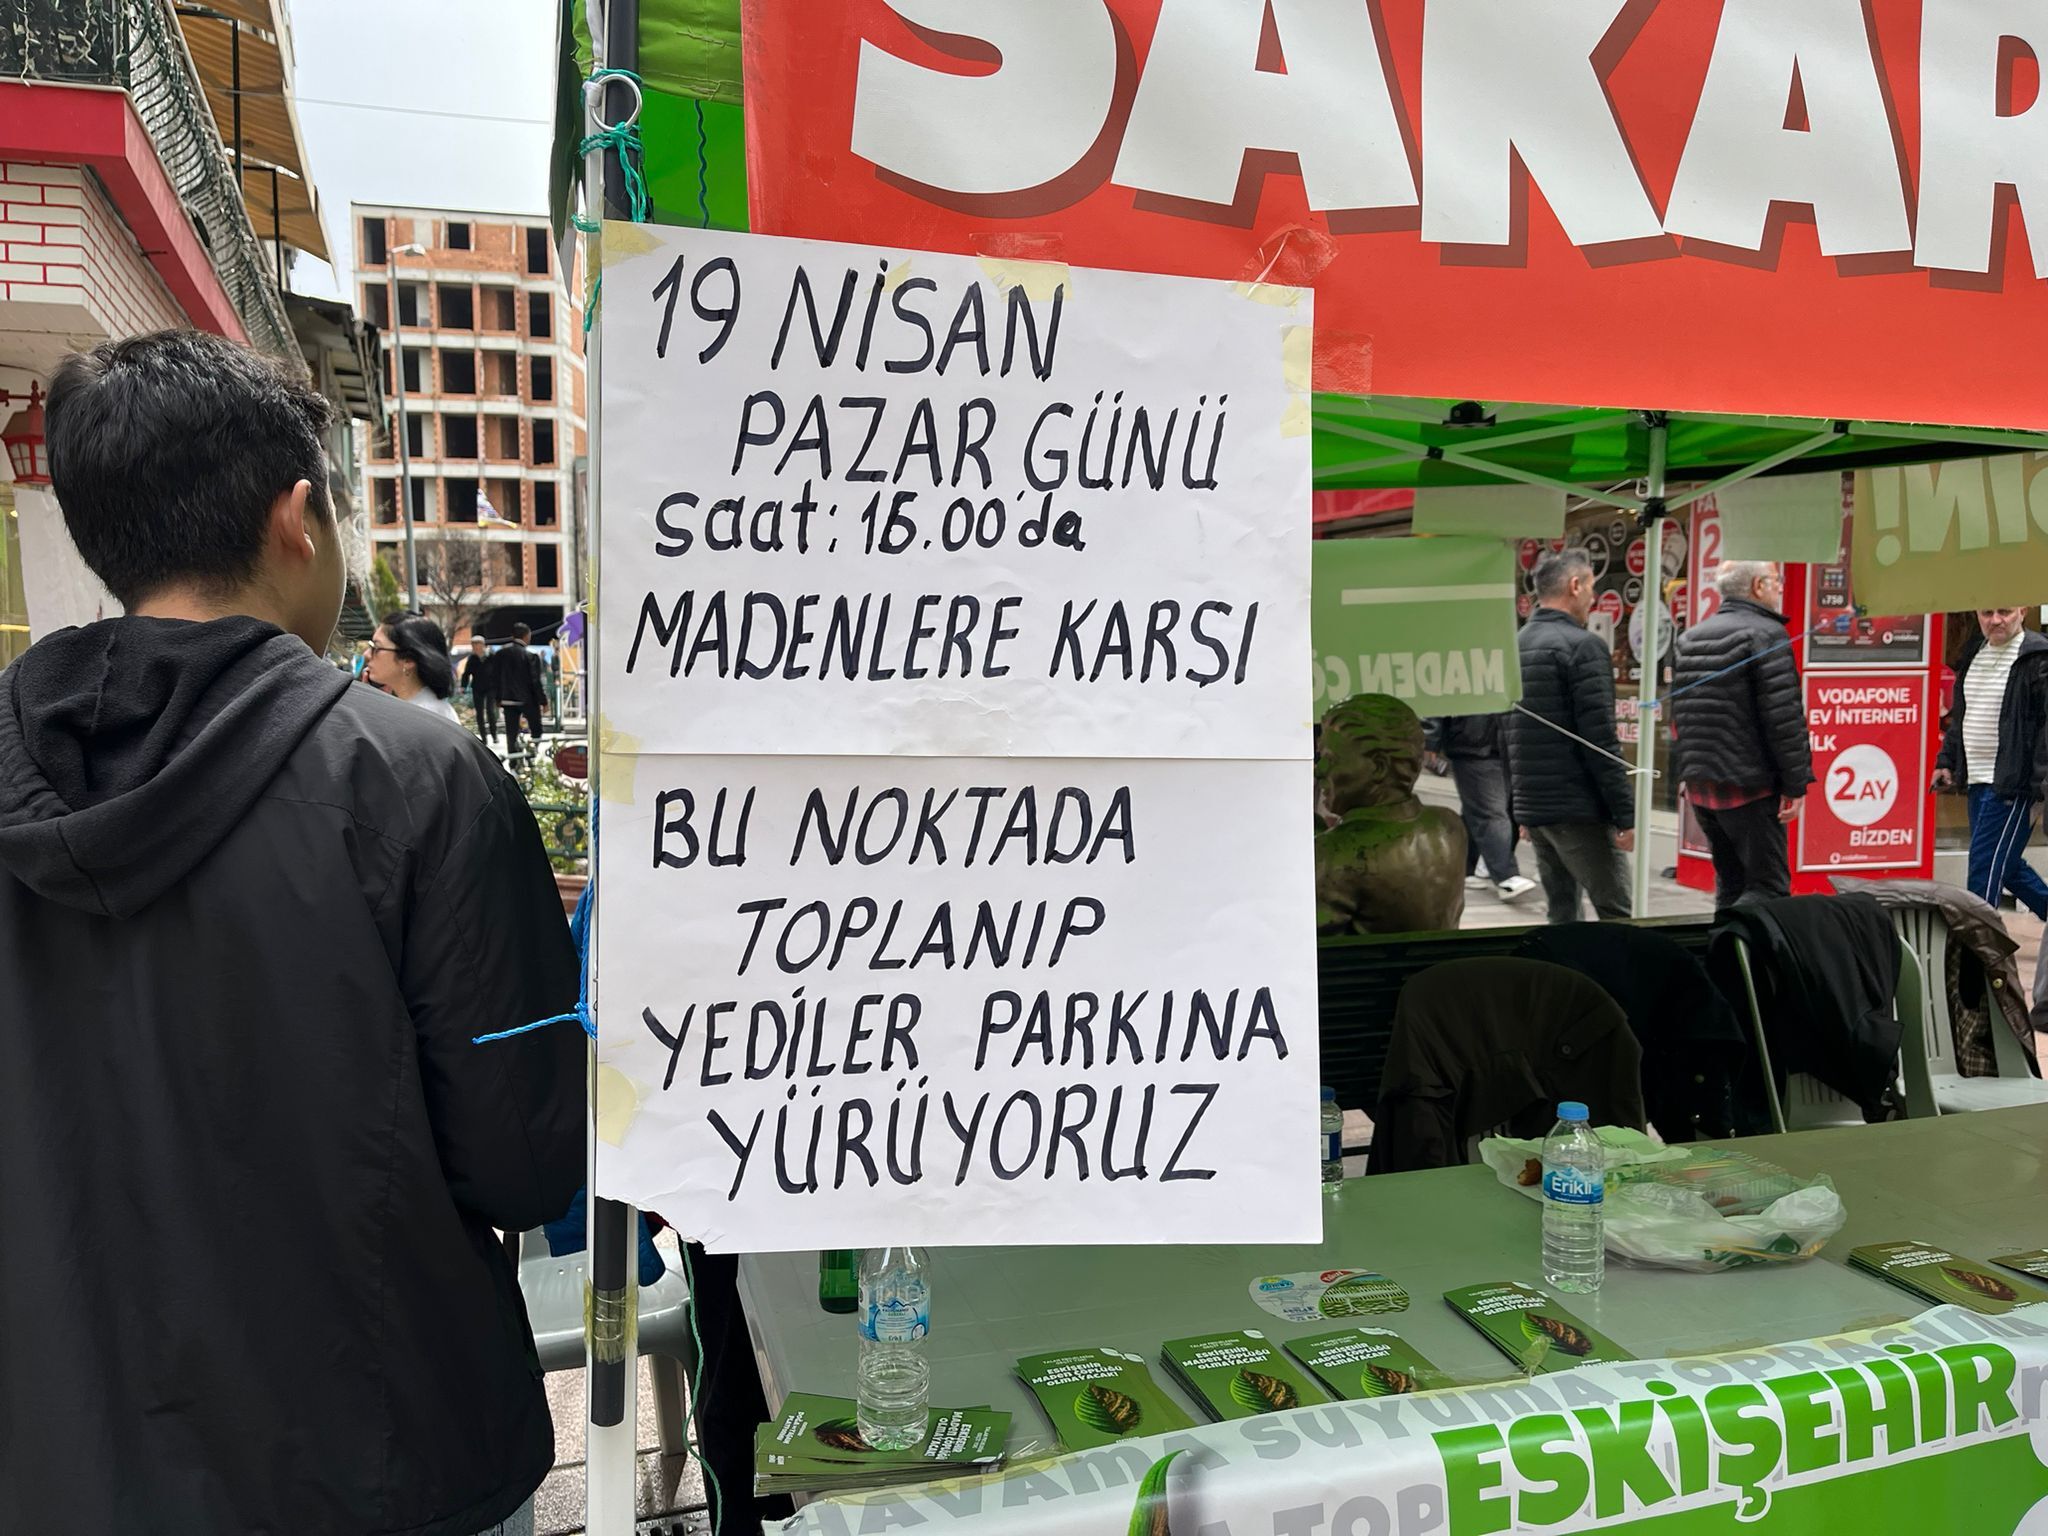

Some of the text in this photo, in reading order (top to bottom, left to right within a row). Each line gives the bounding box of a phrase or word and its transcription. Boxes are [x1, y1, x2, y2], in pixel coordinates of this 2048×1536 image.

[651, 254, 1064, 382] 19 NİSAN
[731, 390, 1228, 492] PAZAR GÜNÜ
[625, 589, 1259, 689] MADENLERE KARŞI
[1809, 704, 1918, 725] EV İNTERNETİ
[1817, 687, 1910, 704] VODAFONE
[1833, 766, 1891, 801] 2 AY
[652, 785, 1136, 869] BU NOKTADA
[1850, 826, 1913, 847] BİZDEN
[736, 896, 1106, 977] TOPLANIP
[642, 985, 1289, 1091] YEDİLER PARKINA
[706, 1075, 1220, 1202] YÜRÜYORUZ
[1552, 1176, 1593, 1195] Erikli
[1432, 1343, 2019, 1536] ESKİŞEHİR
